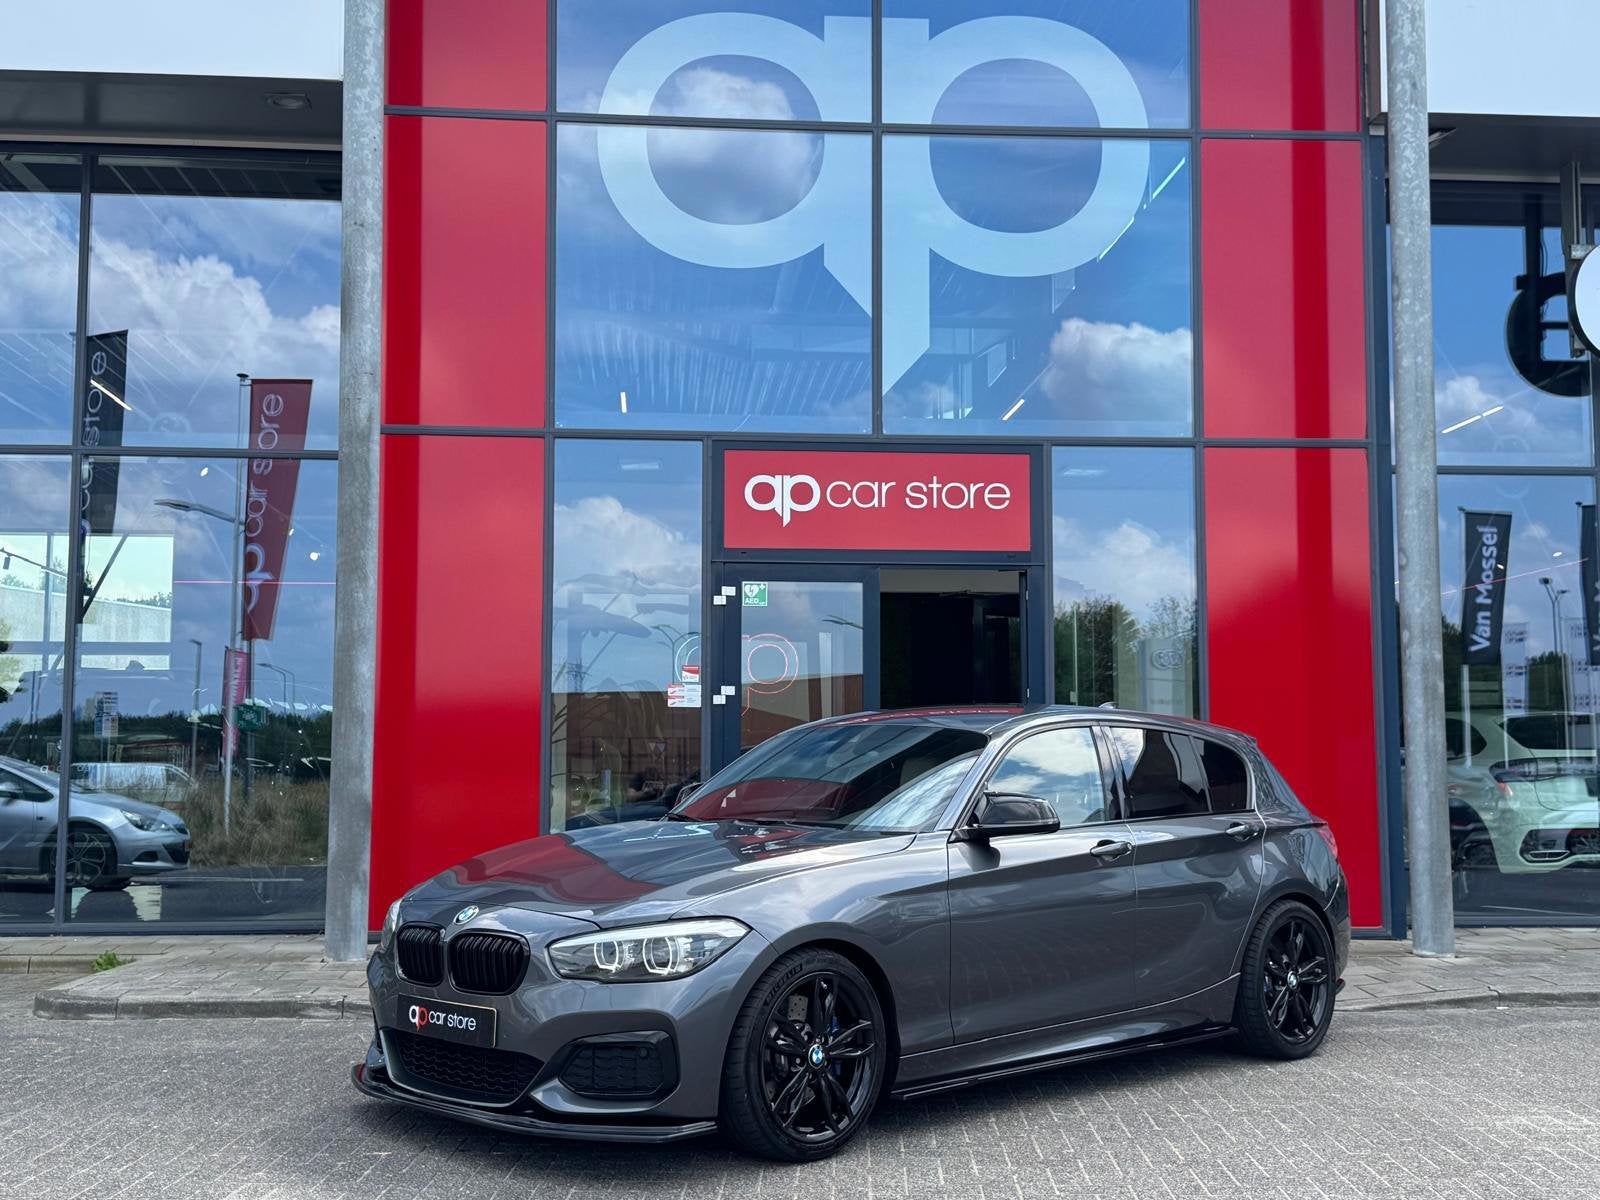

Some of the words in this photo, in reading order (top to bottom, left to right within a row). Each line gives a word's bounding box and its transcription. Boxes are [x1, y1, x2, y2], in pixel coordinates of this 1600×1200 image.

[252, 393, 284, 476] sore
[246, 480, 269, 538] car
[744, 474, 821, 527] ap
[826, 480, 896, 508] car
[905, 475, 1011, 510] store
[1474, 524, 1498, 605] Mossel
[1467, 610, 1491, 653] Van
[428, 1011, 446, 1025] car
[447, 1013, 477, 1031] store
